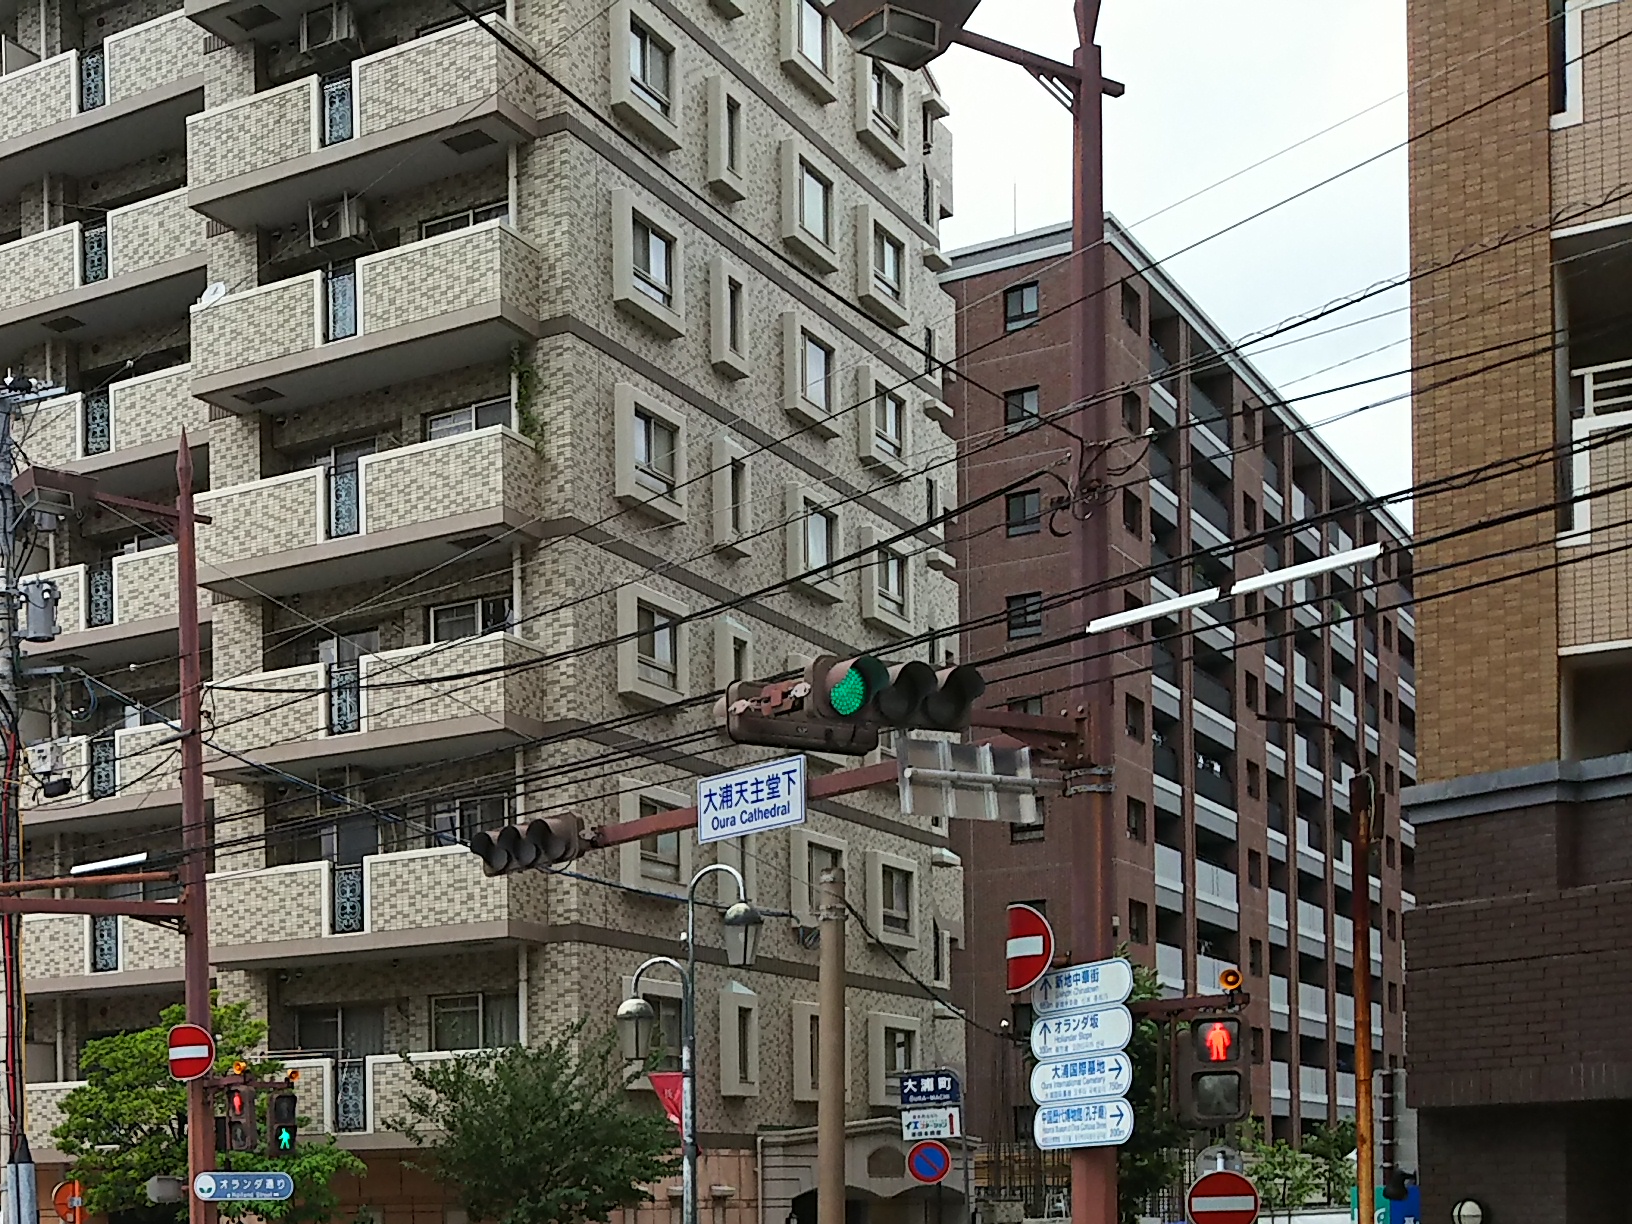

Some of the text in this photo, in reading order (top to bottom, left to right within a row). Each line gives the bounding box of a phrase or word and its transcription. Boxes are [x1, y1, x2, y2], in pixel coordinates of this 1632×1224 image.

[703, 768, 798, 815] 大浦天主堂下
[711, 800, 791, 831] Oura Cathedral
[1054, 1014, 1099, 1034] オランダ坂
[903, 1076, 952, 1094] 大浦町
